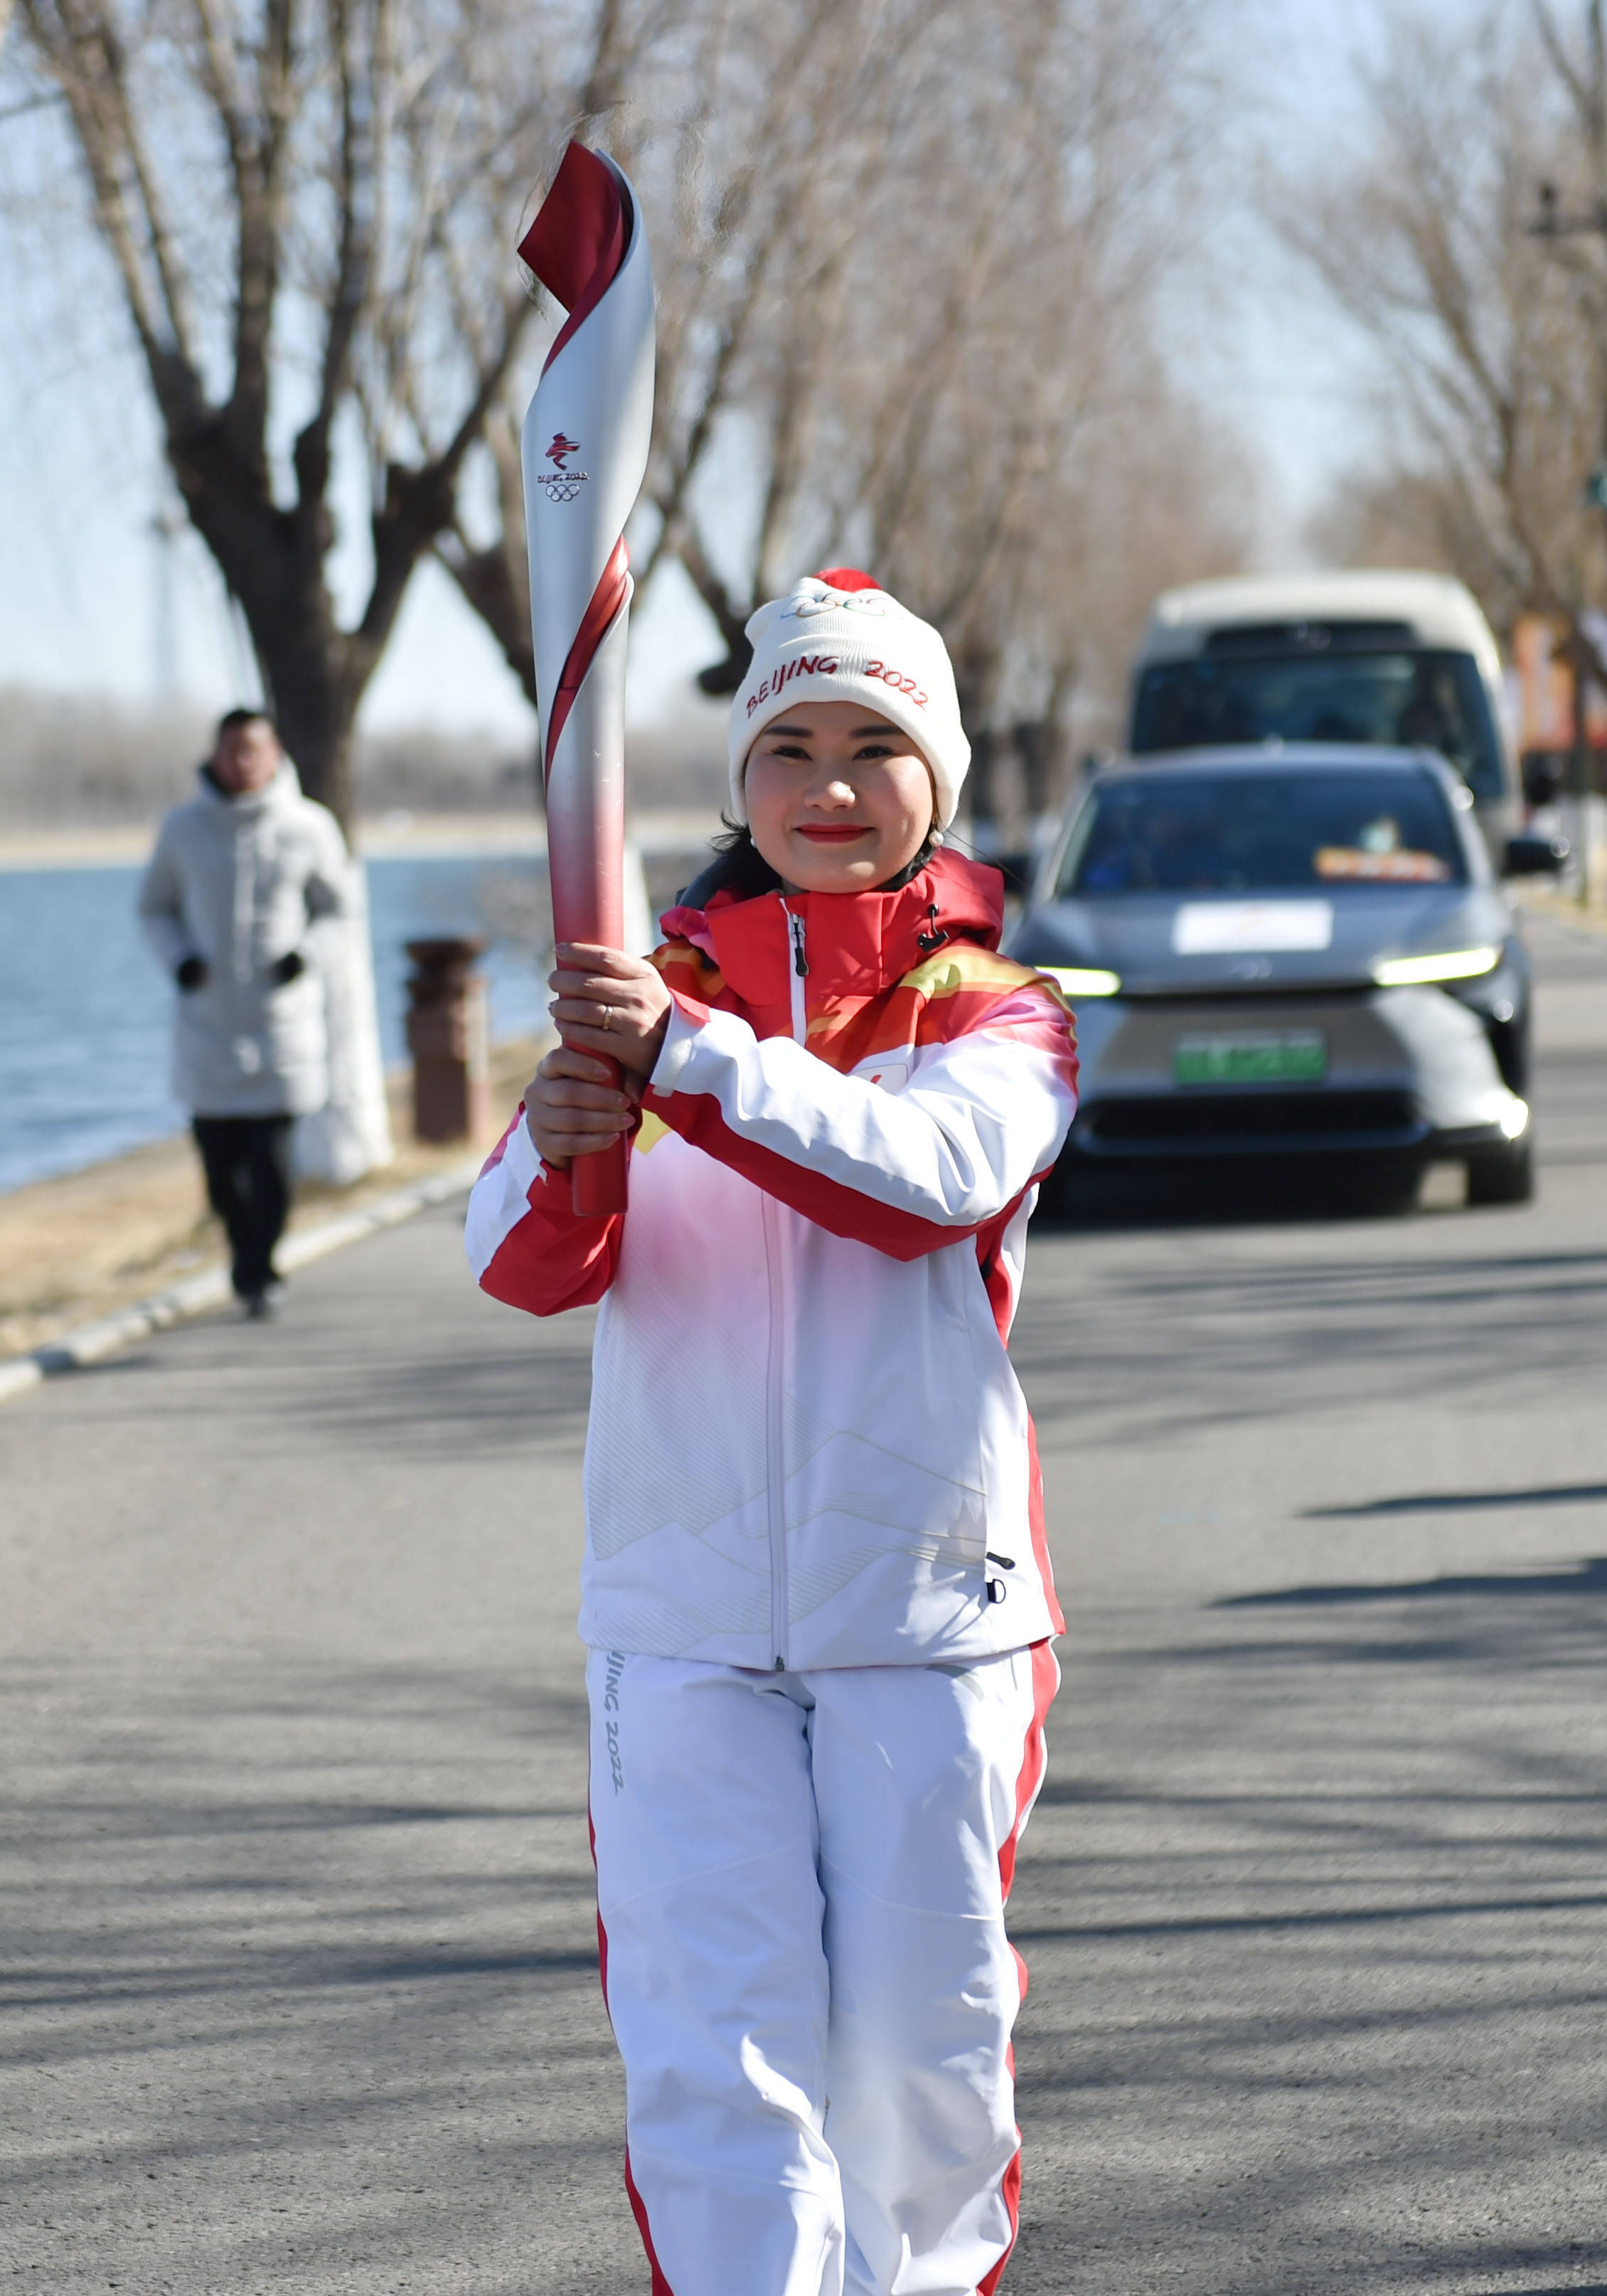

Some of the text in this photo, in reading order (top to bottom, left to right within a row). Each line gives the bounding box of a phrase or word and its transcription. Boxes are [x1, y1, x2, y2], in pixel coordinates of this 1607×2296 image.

[746, 656, 929, 719] BEIJING 2022
[606, 1721, 624, 1797] 2022
